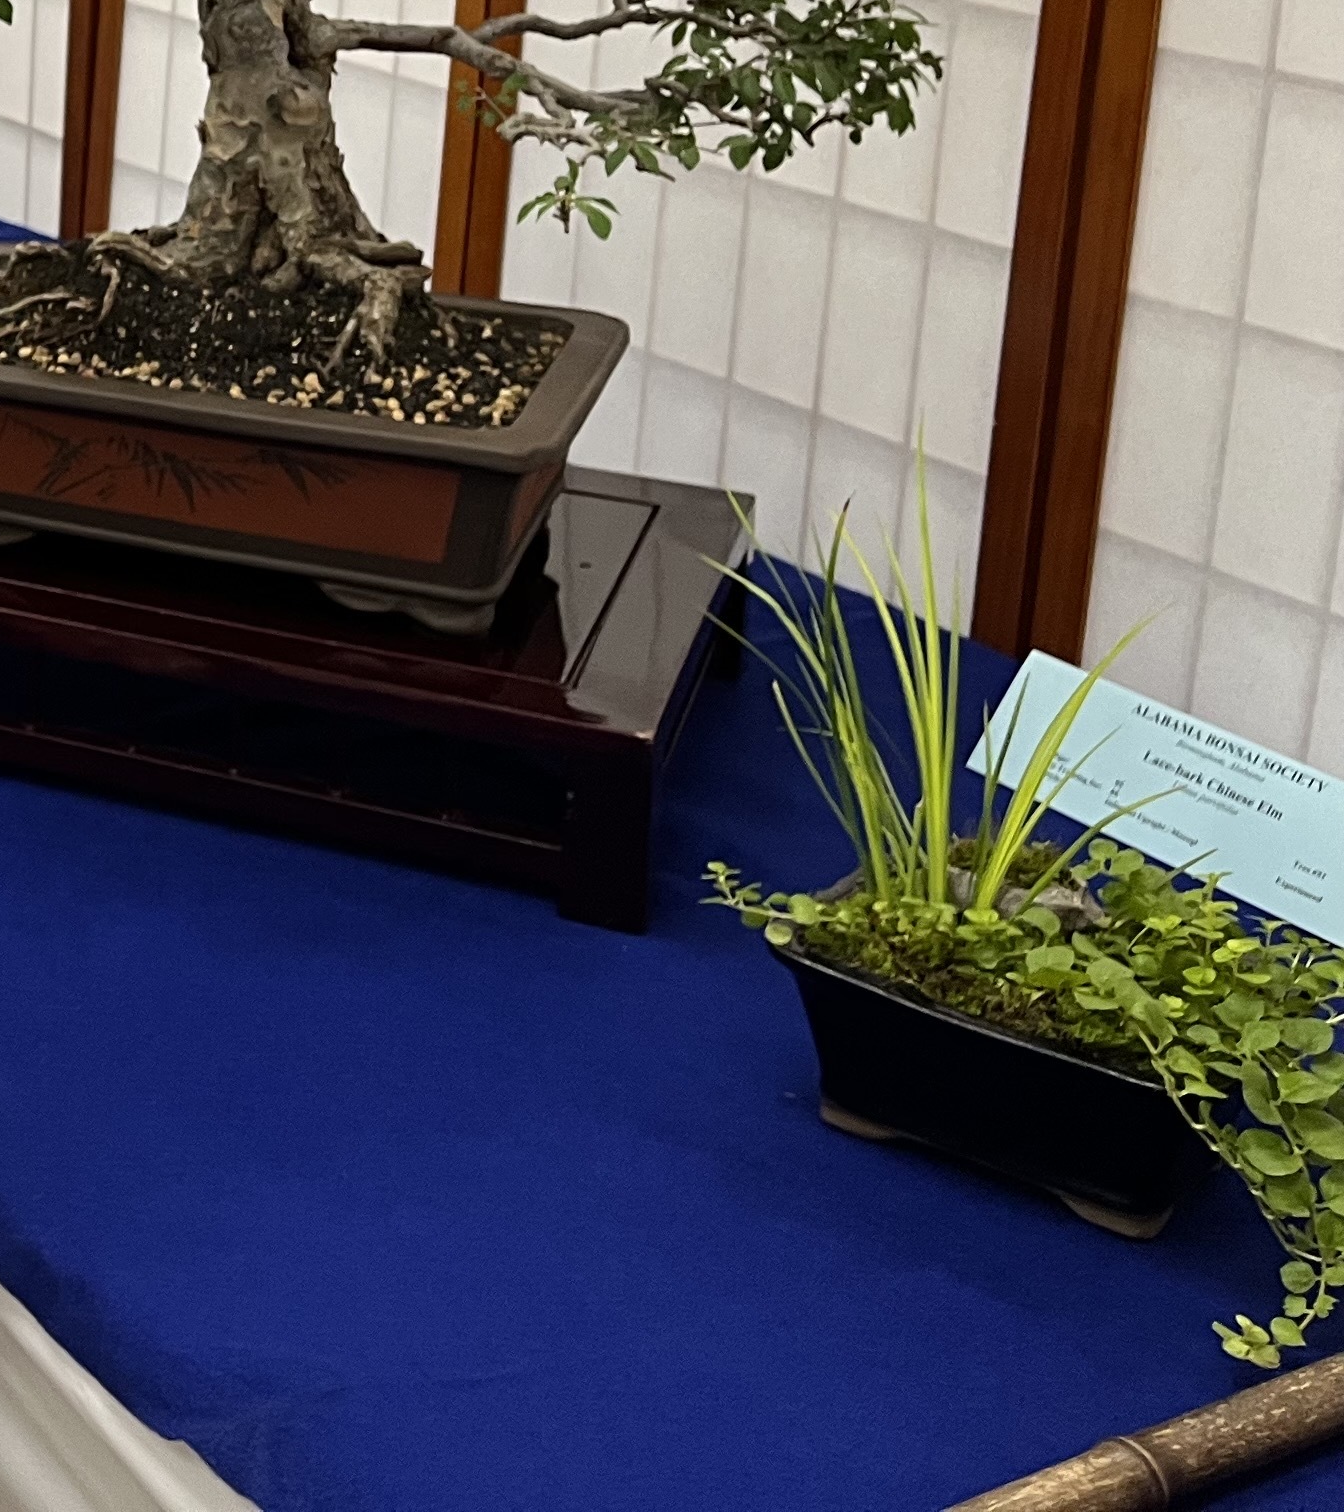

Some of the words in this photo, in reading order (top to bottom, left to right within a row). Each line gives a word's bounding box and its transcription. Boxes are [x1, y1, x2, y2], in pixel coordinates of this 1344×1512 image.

[1131, 701, 1203, 743] ALABAMA
[1207, 732, 1261, 769] BONSAI
[1260, 755, 1329, 794] SOCIETY
[1207, 775, 1256, 808] Chinese
[1257, 800, 1284, 822] Elm
